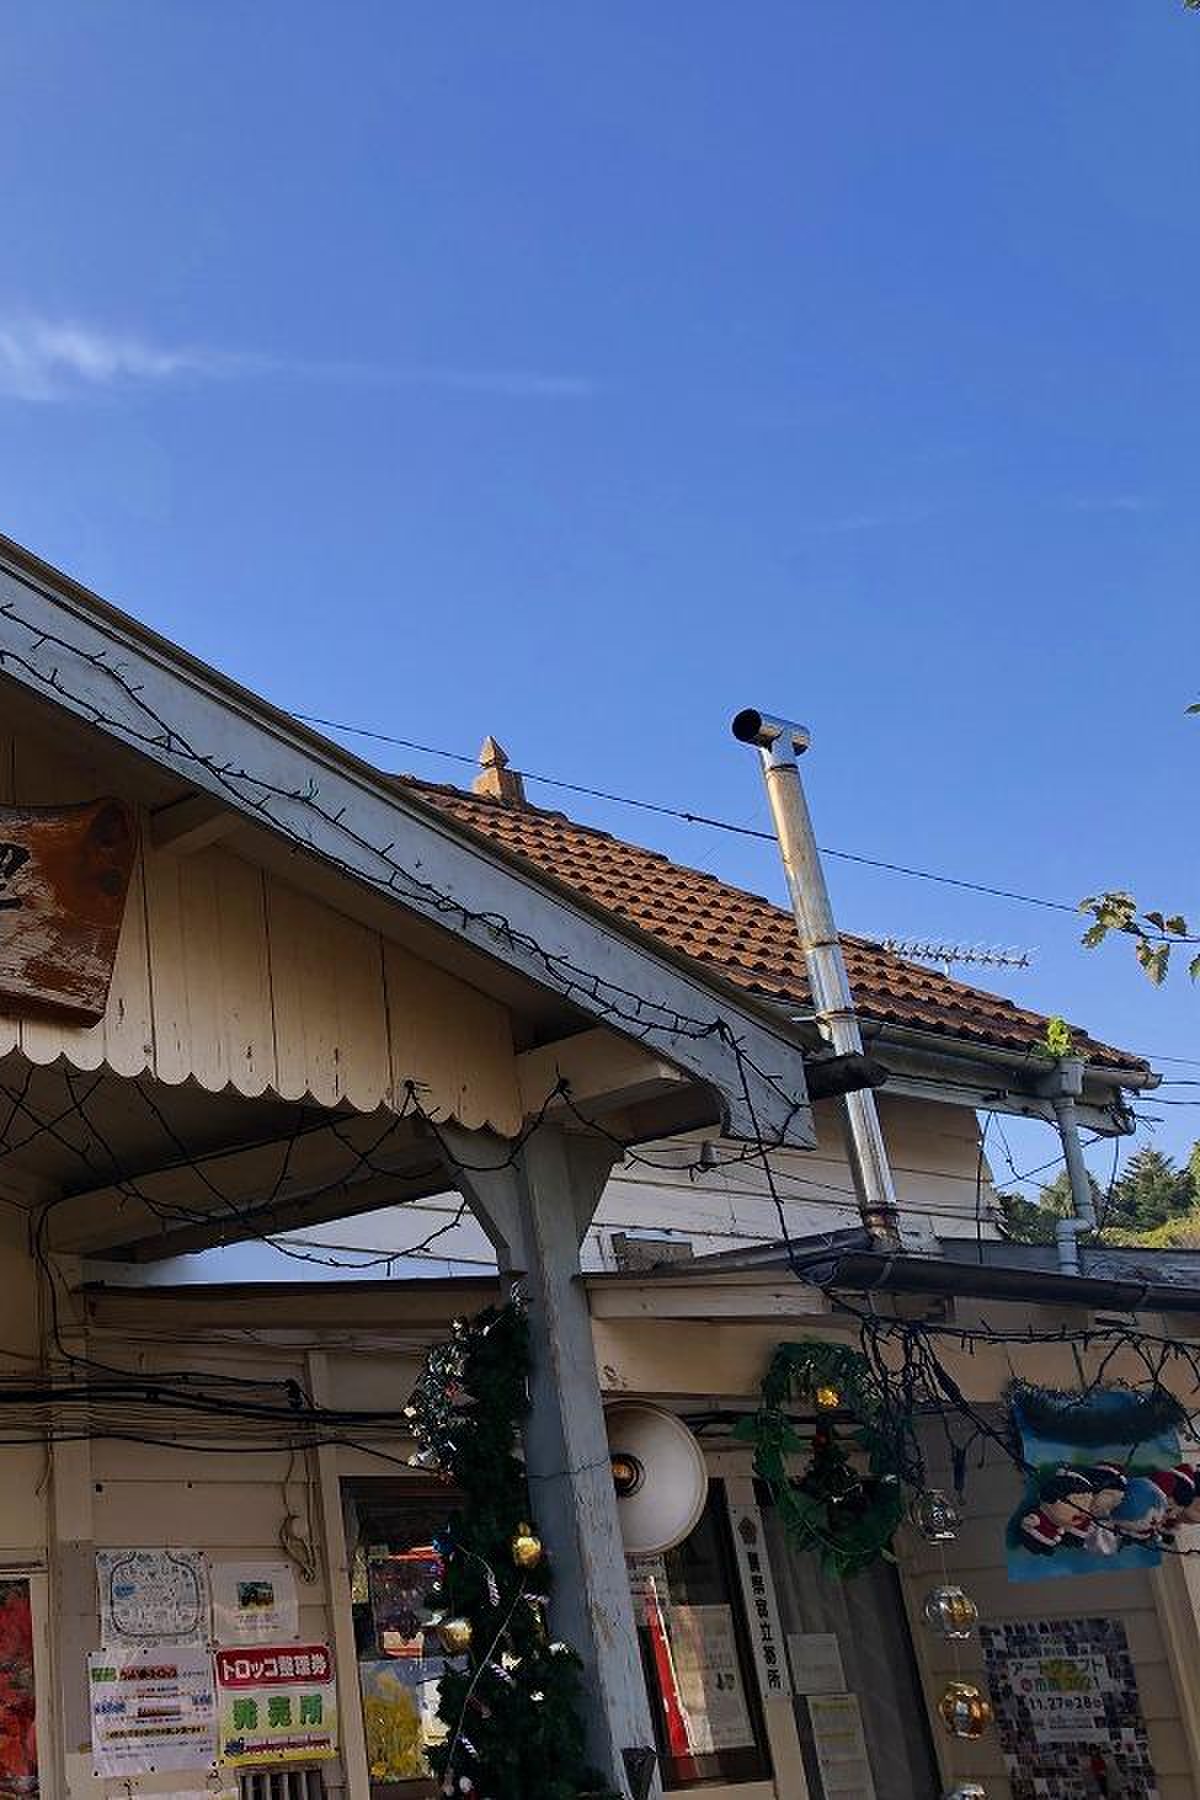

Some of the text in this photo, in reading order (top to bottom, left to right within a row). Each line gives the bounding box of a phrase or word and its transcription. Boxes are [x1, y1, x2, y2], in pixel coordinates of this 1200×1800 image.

[222, 1653, 327, 1681] トロッコ整理券
